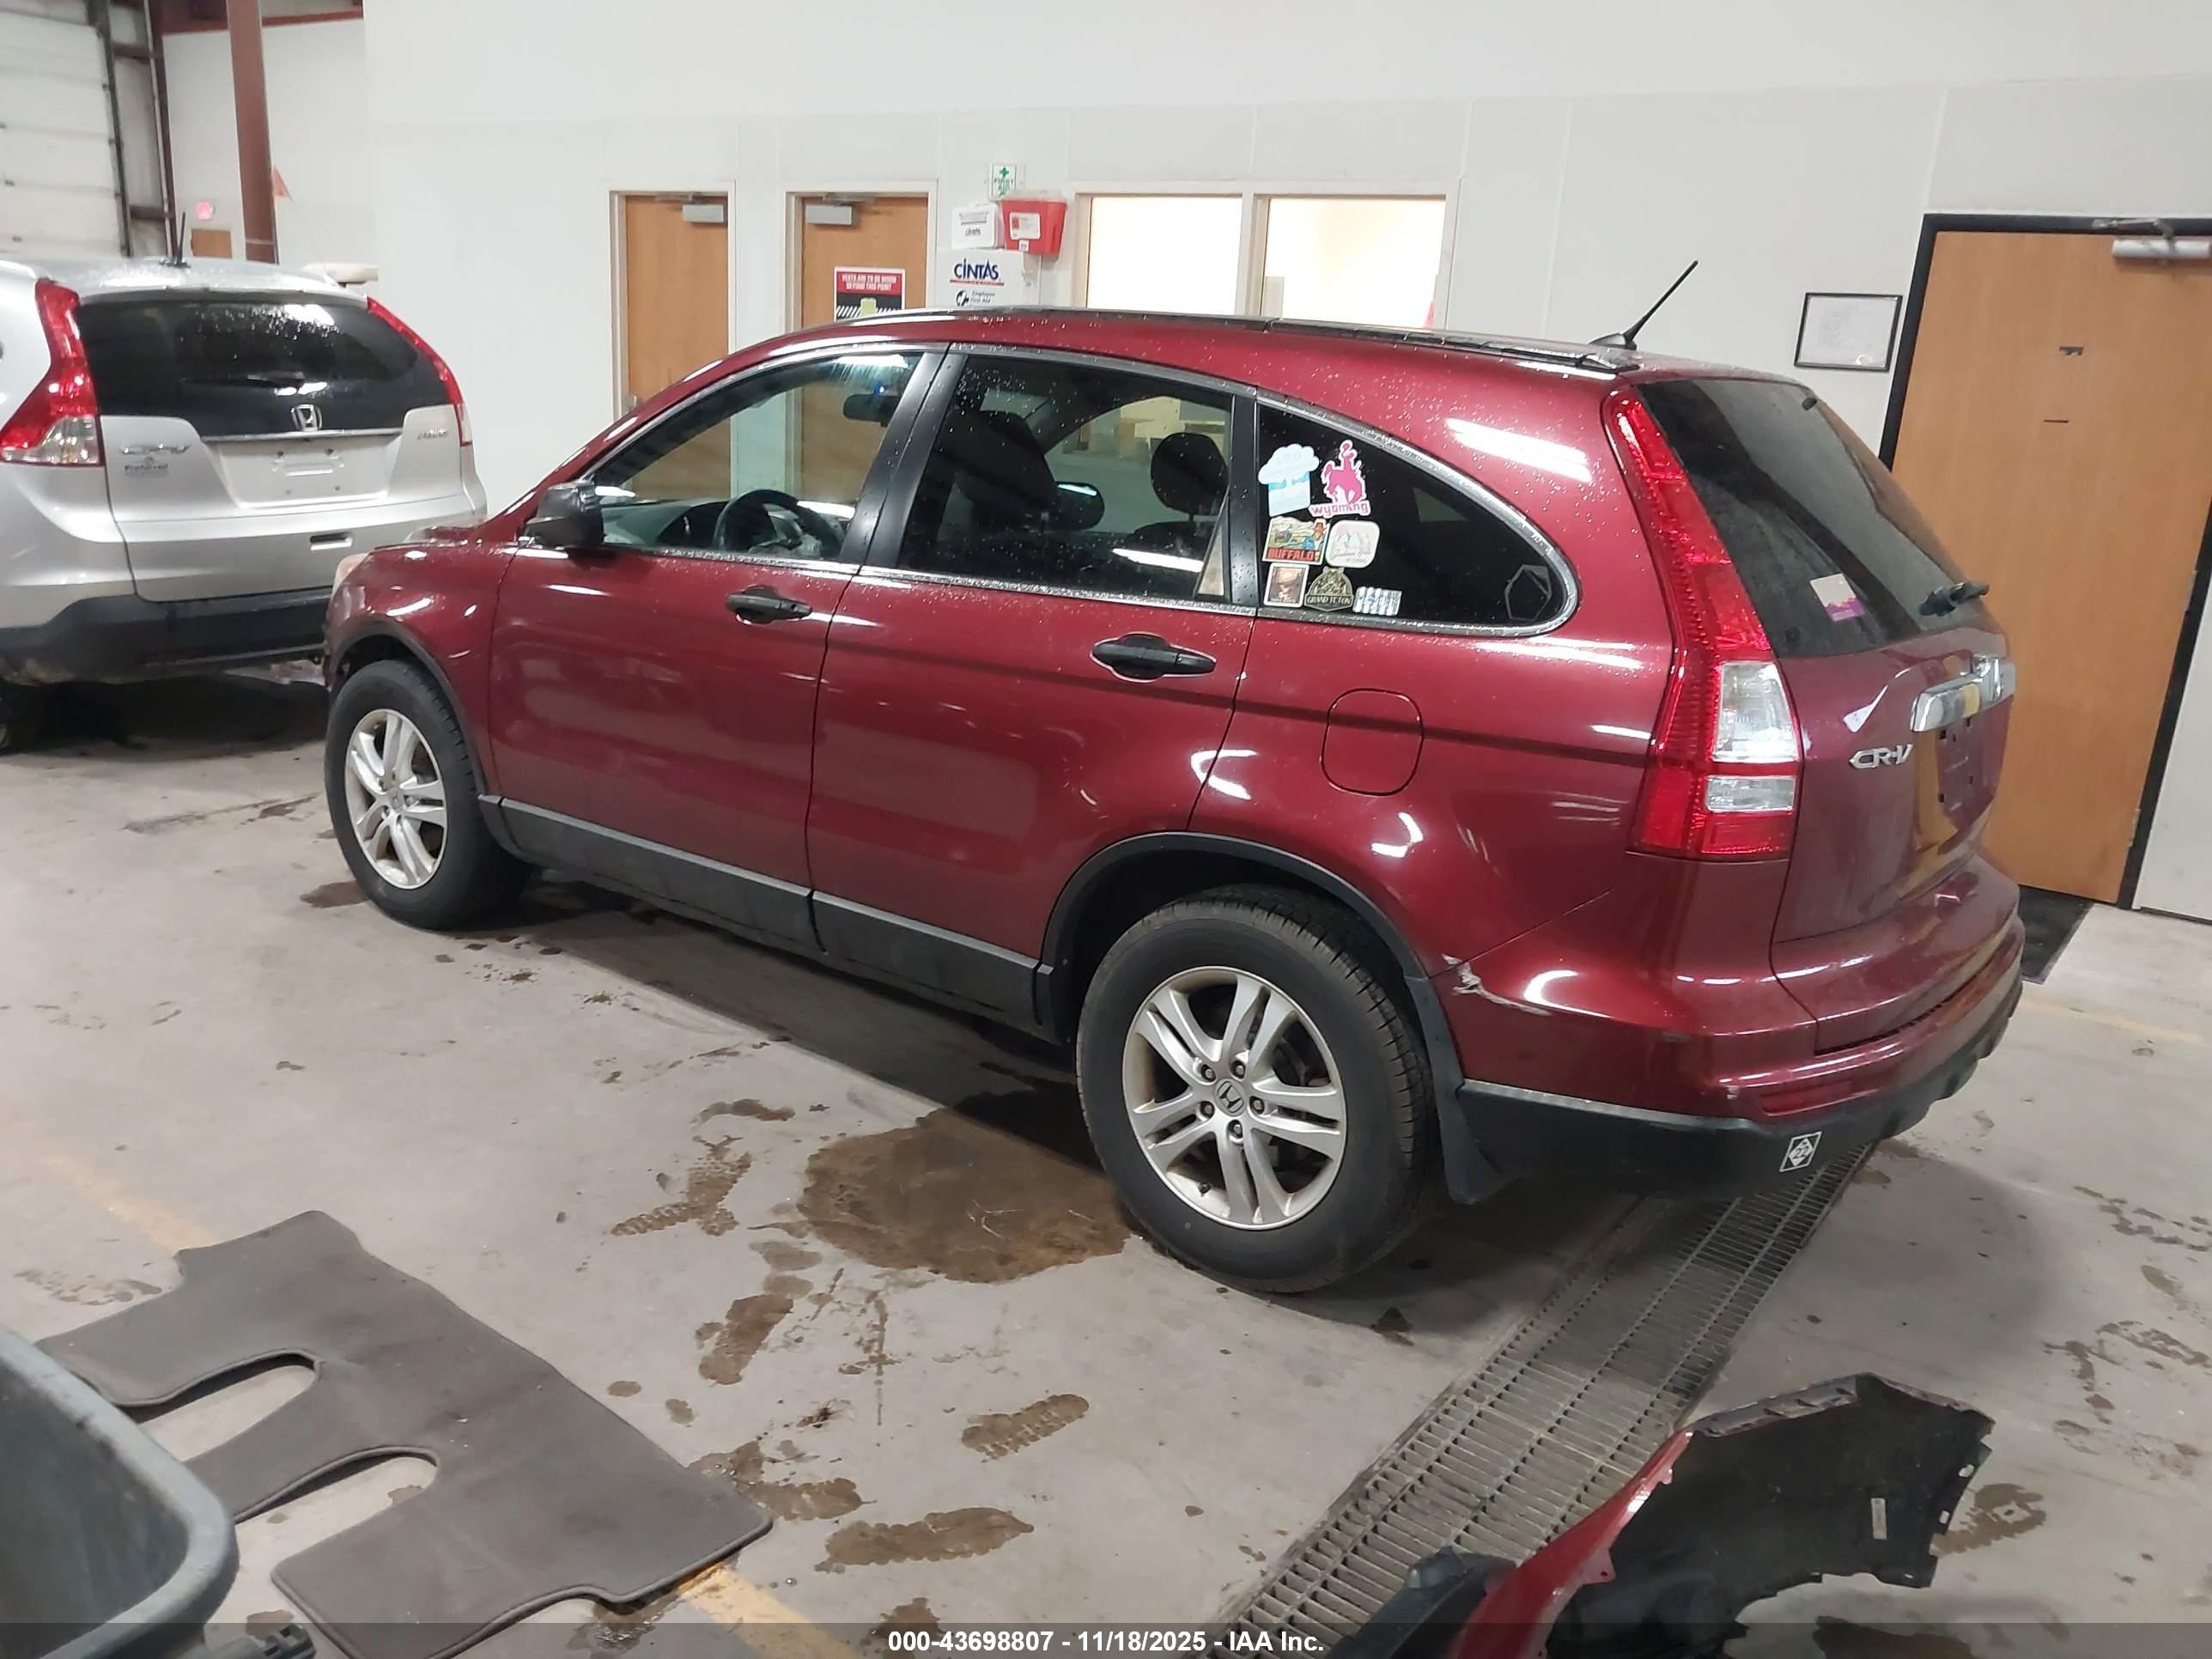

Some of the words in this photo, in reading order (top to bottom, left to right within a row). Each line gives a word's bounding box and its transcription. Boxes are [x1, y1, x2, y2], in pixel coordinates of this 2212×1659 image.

[953, 258, 999, 280] CINTAS
[1310, 502, 1369, 516] wyoming
[1849, 744, 1913, 769] CR-V
